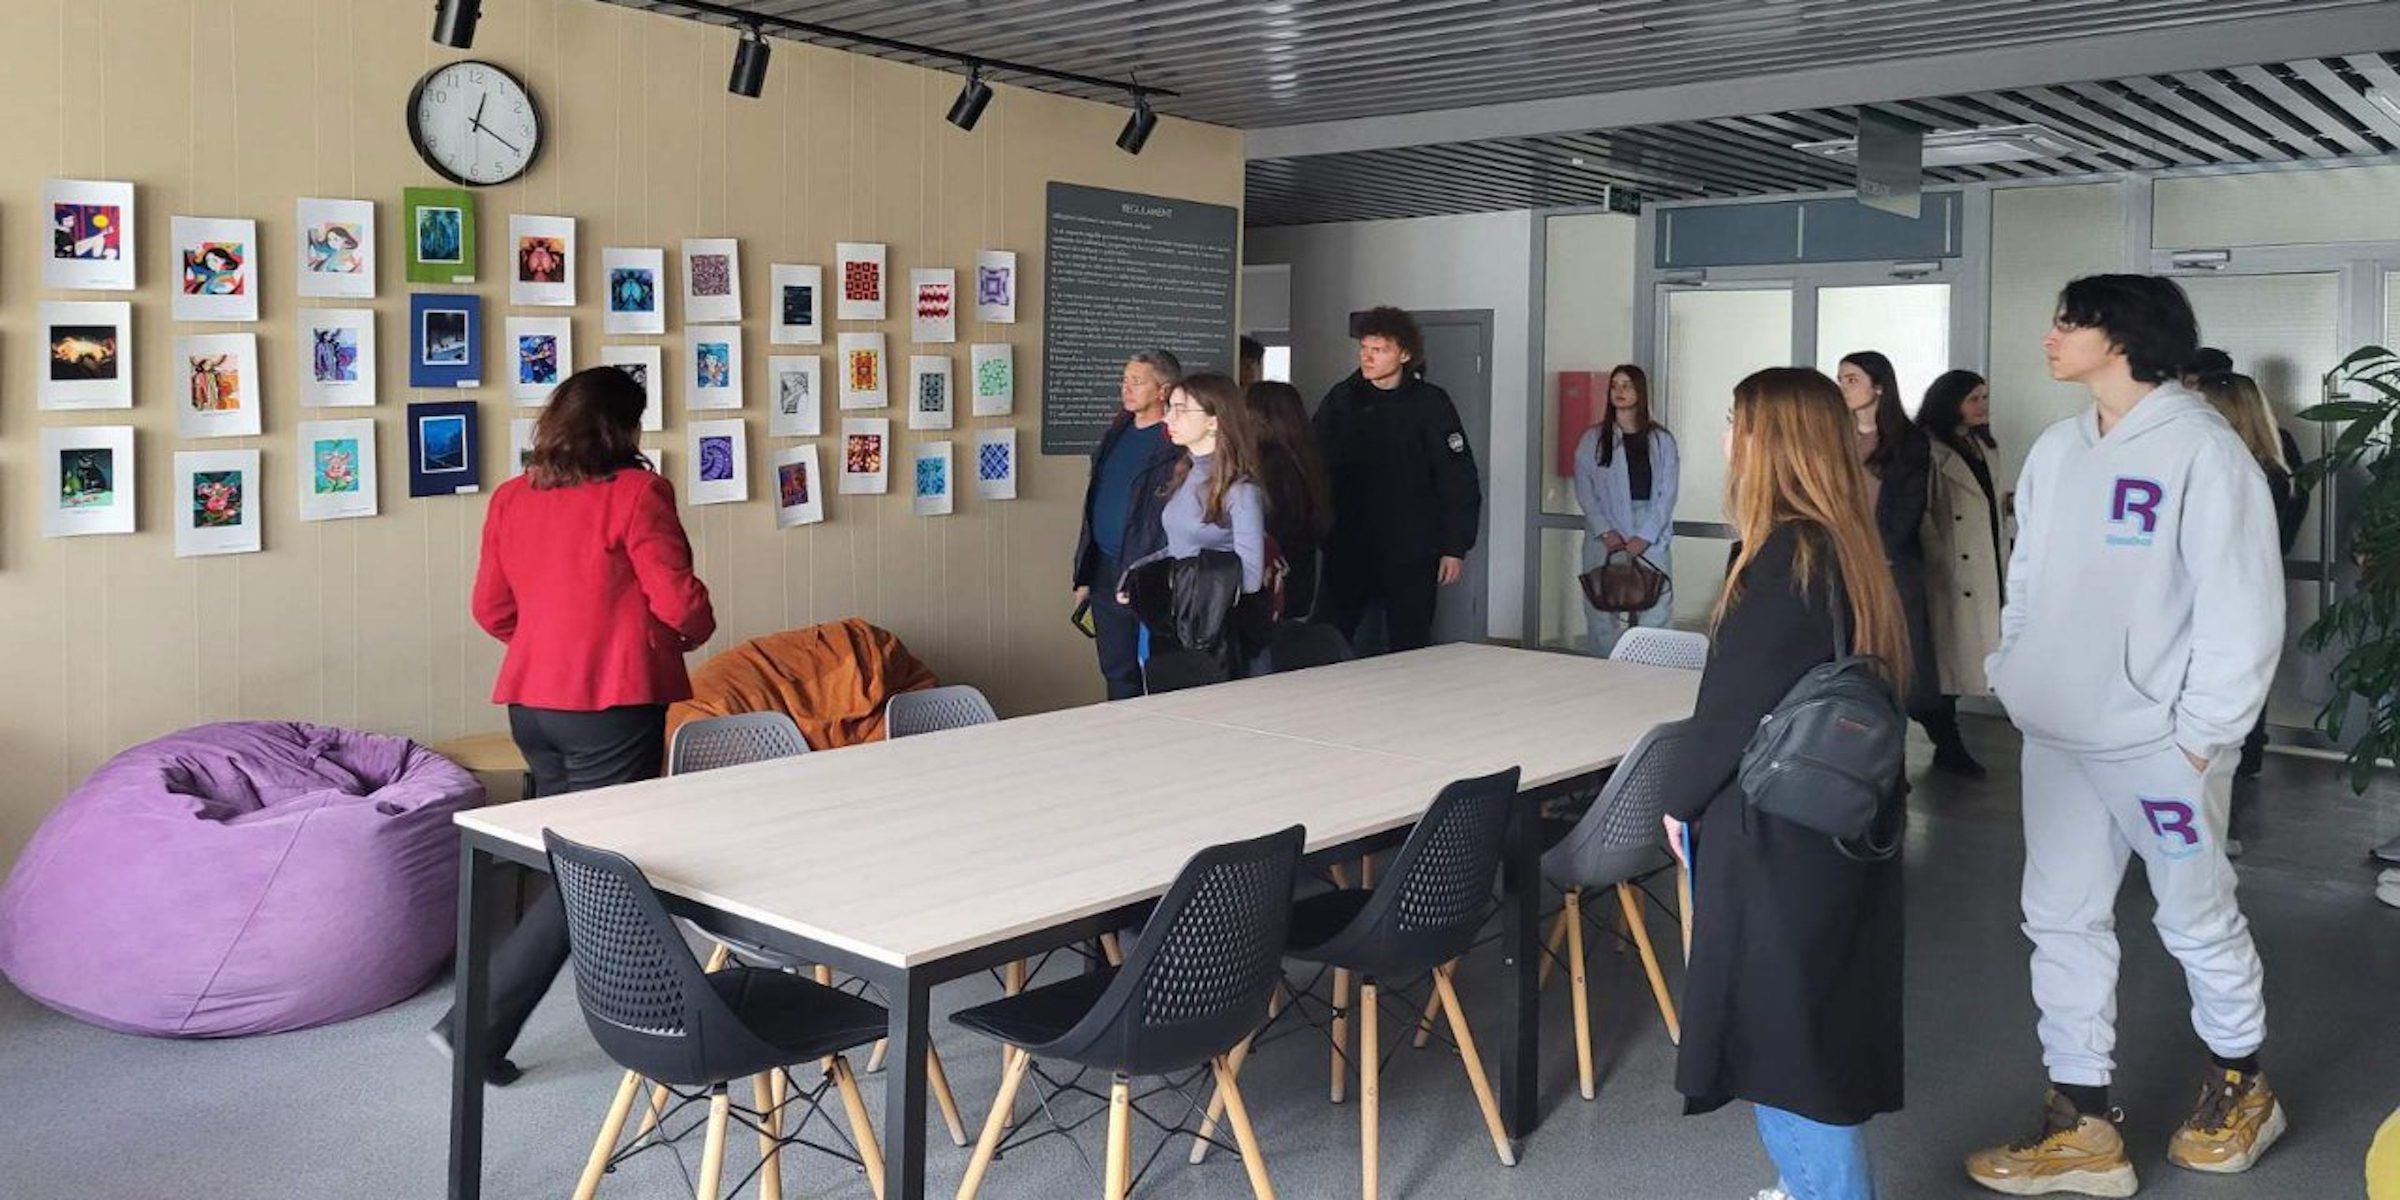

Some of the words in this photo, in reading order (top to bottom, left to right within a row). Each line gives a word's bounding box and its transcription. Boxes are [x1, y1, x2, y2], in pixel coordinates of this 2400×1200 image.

[447, 73, 459, 88] 11
[468, 70, 484, 85] 12
[498, 82, 505, 95] 1
[425, 88, 448, 104] 10
[513, 101, 523, 114] 2
[421, 108, 430, 122] 9
[520, 124, 530, 138] 3
[428, 136, 437, 148] 8
[448, 153, 456, 166] 7
[470, 162, 479, 177] 6
[494, 162, 504, 174] 5
[1121, 203, 1174, 219] REGULAMENT
[2112, 478, 2162, 532] R
[2140, 799, 2198, 845] R
